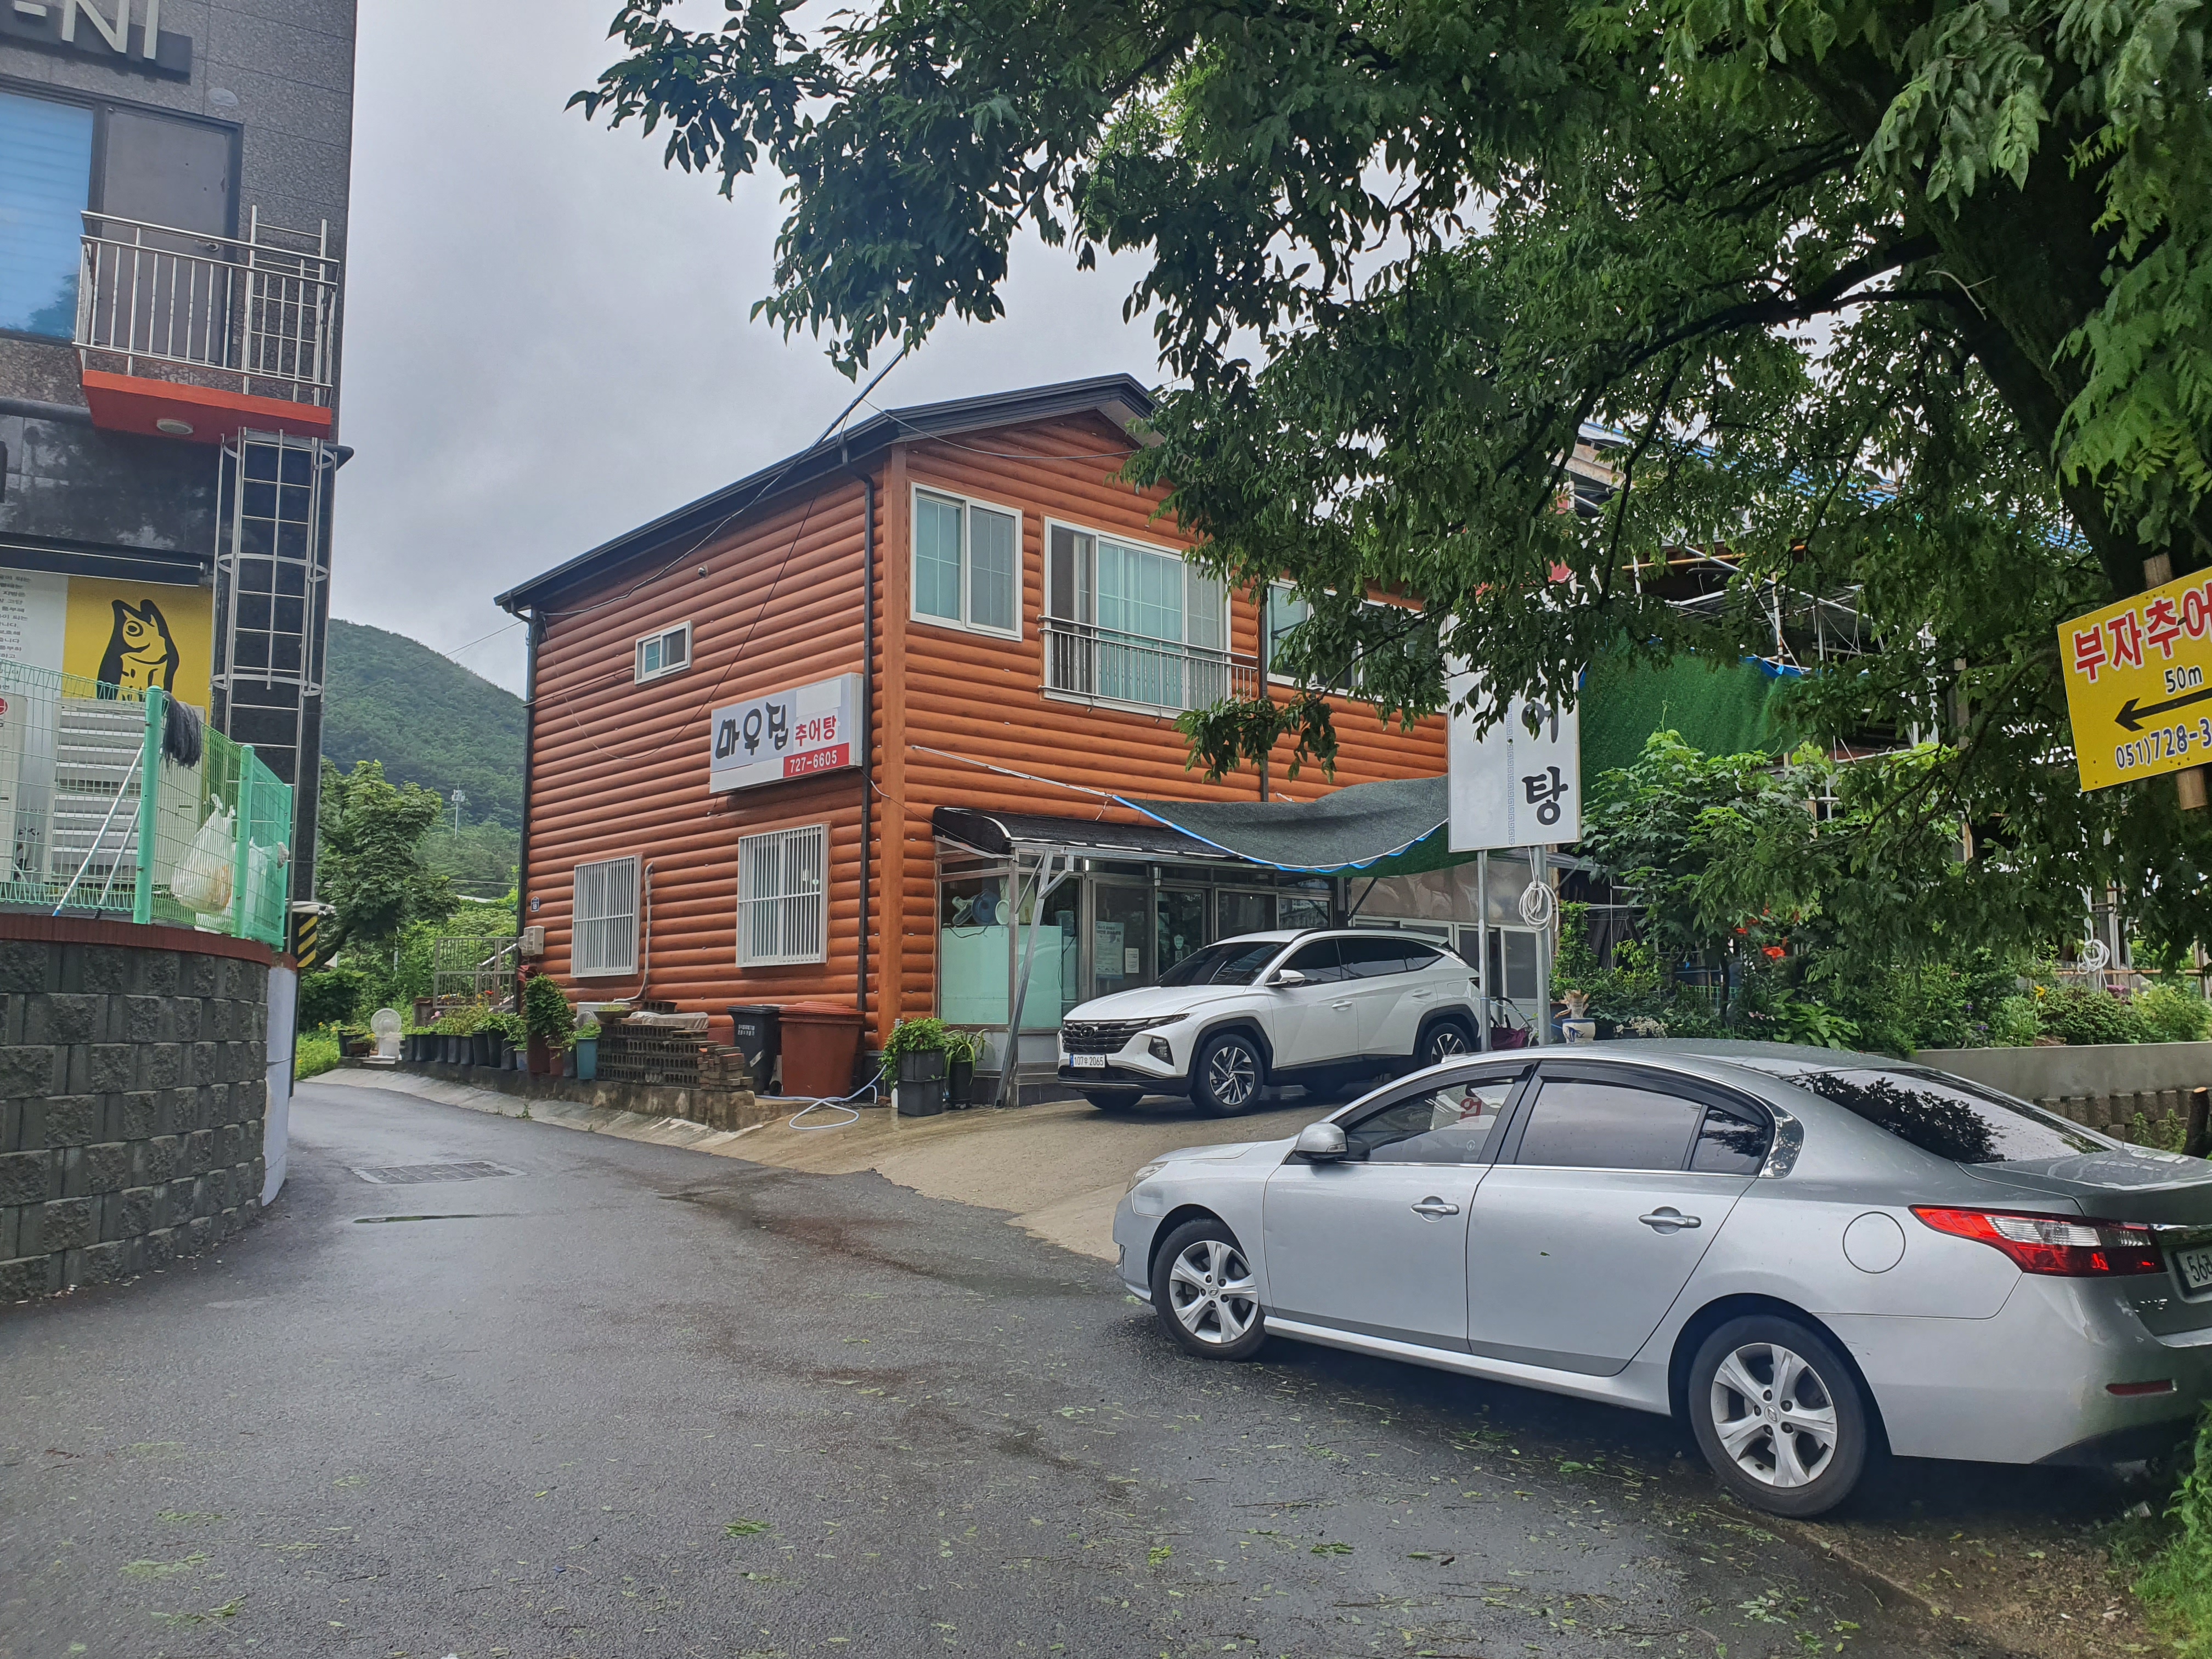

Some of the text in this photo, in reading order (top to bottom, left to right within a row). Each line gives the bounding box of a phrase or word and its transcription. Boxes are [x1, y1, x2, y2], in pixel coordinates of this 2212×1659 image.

[2165, 666, 2203, 693] 50m
[795, 715, 837, 747] 추어탕
[790, 749, 837, 774] 727-6605
[1521, 689, 1569, 826] 어탕
[1090, 1056, 1103, 1065] 2065
